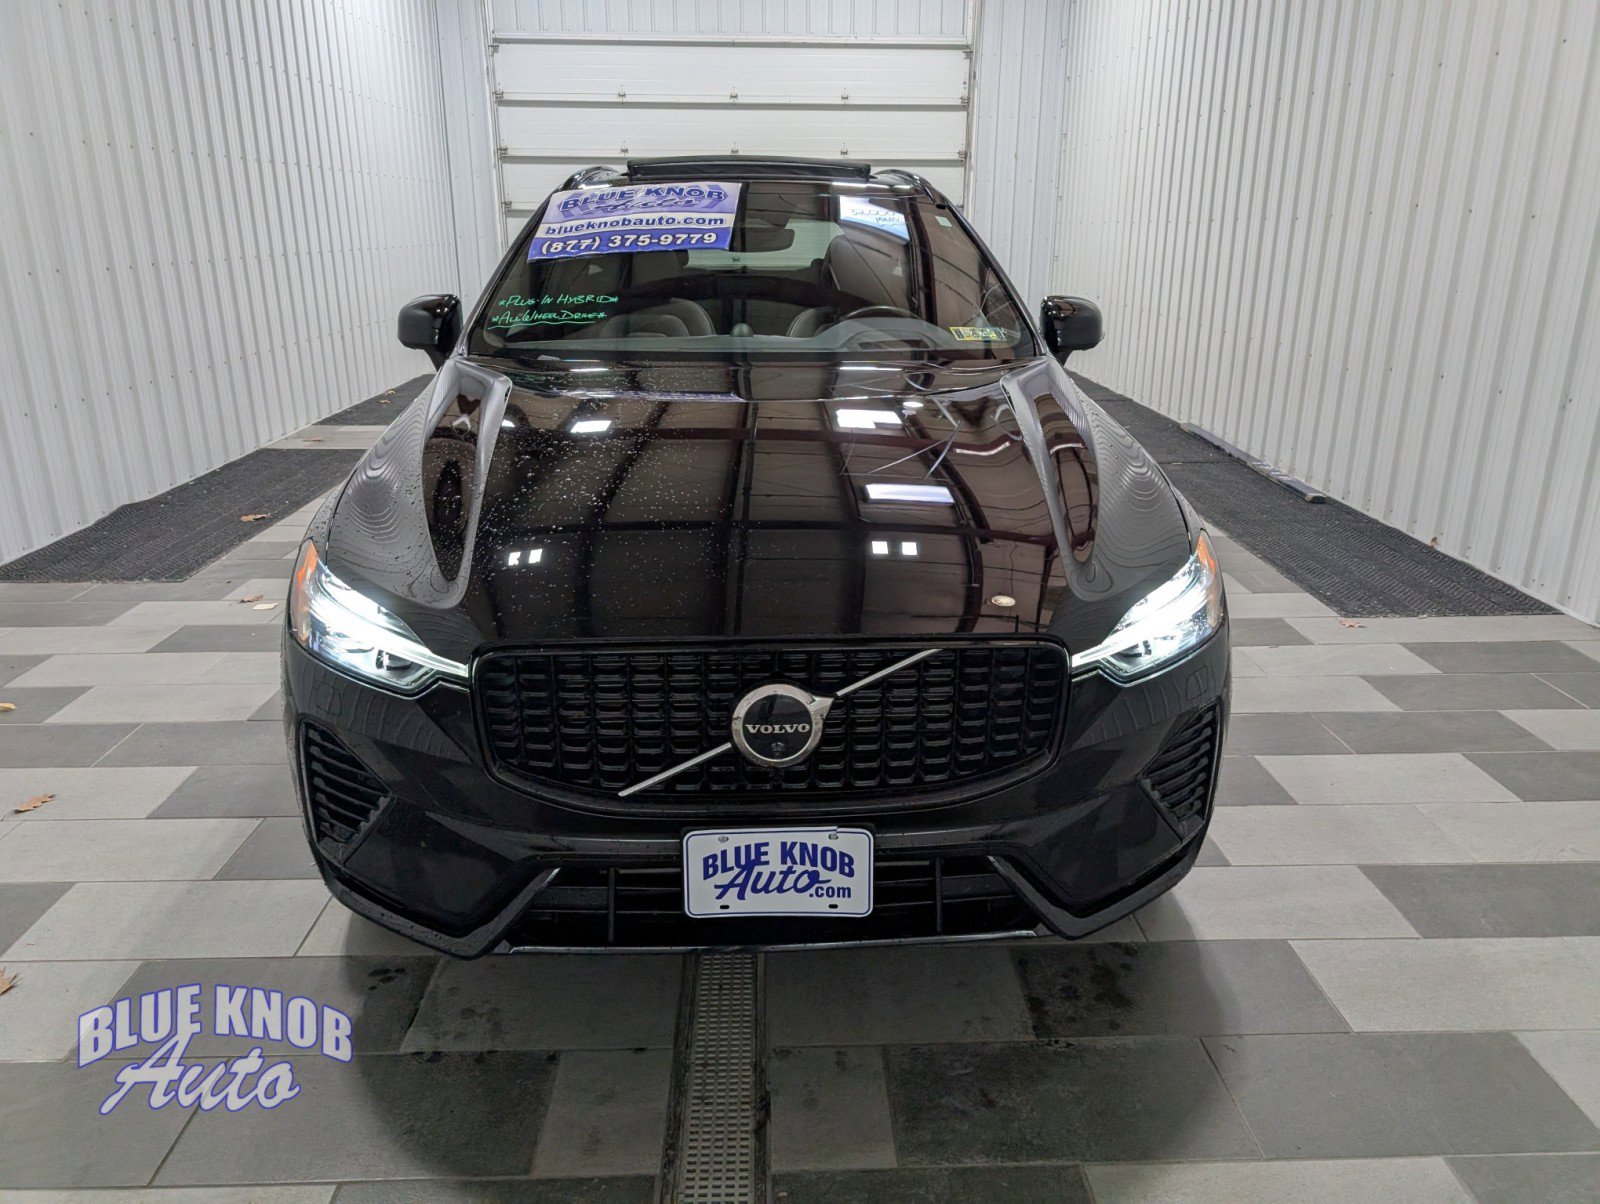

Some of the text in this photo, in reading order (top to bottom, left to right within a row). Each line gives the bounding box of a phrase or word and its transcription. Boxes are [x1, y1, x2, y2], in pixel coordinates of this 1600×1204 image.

[560, 186, 727, 211] BLUE KNOB
[545, 215, 725, 236] blueknobauto.com
[541, 232, 717, 255] (877) 375-9779
[745, 723, 811, 734] VOLVO
[702, 841, 855, 881] BLUE KNOB
